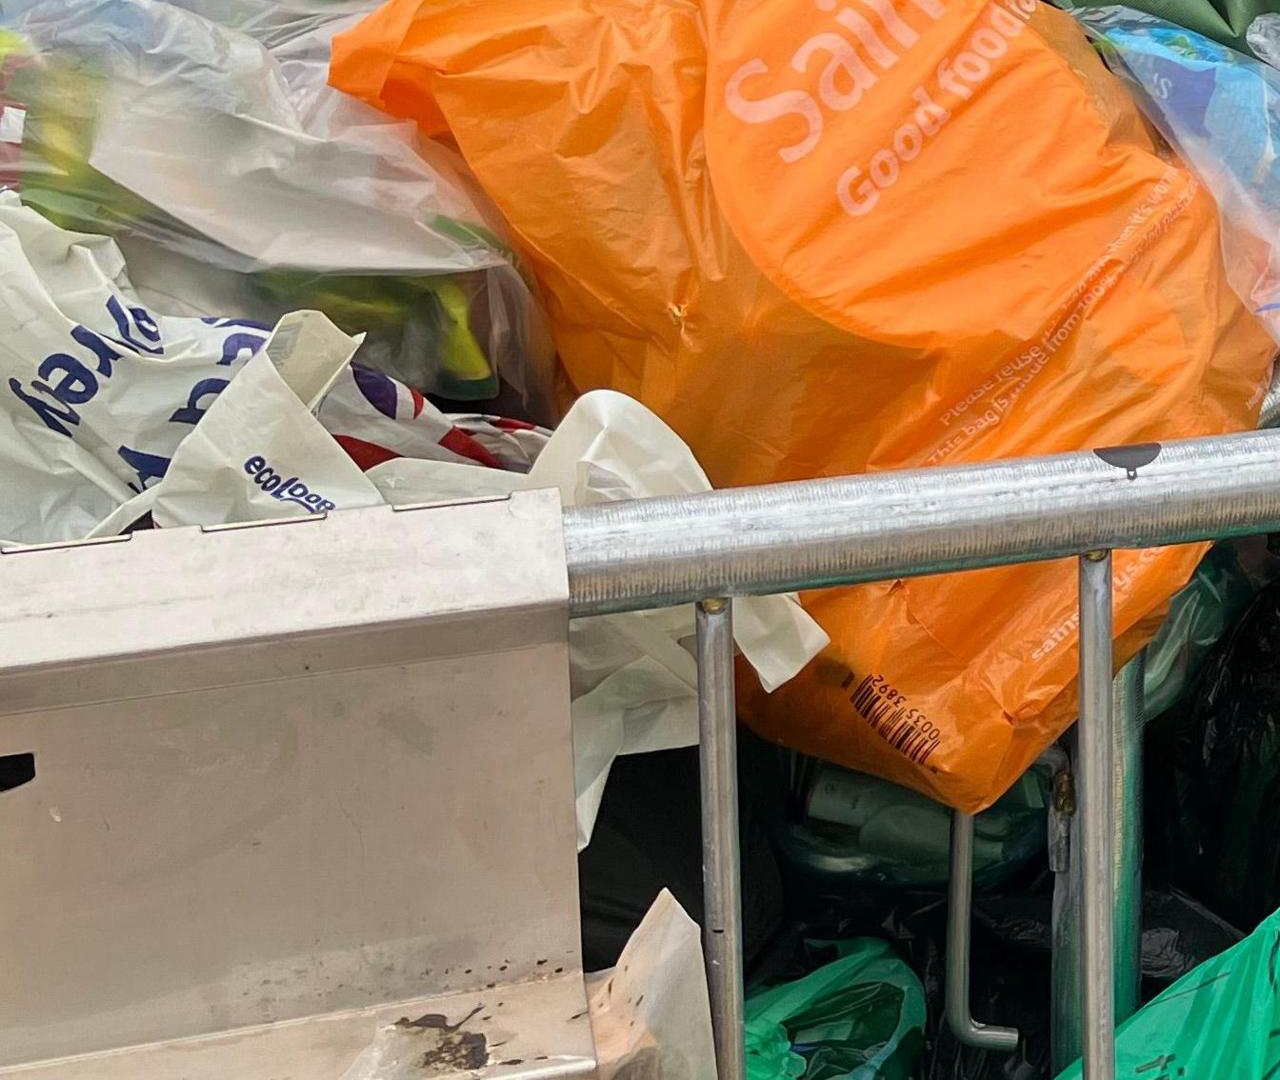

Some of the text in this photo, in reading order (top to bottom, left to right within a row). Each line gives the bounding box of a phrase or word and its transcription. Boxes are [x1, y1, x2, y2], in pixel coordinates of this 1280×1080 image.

[836, 86, 951, 217] Good
[939, 376, 998, 427] Please
[961, 408, 1001, 437] bag
[990, 393, 1011, 412] is
[1043, 311, 1083, 354] from
[243, 455, 337, 513] ecoloop
[872, 673, 942, 743] 0035 3892
